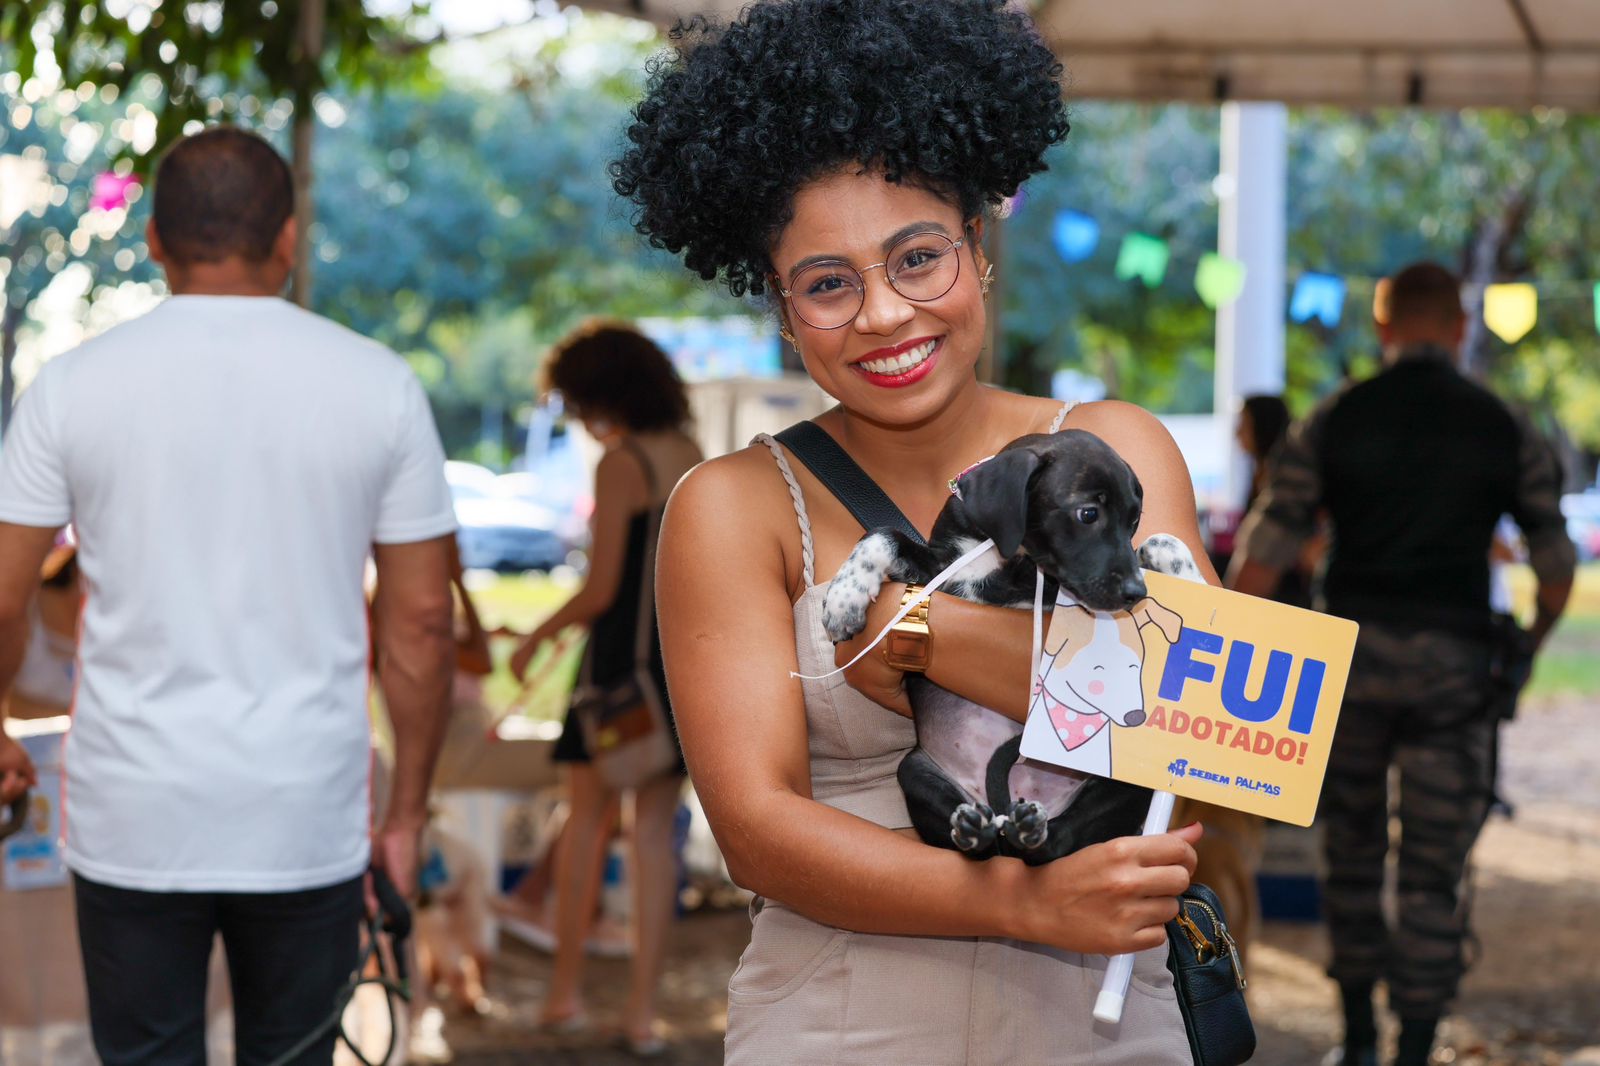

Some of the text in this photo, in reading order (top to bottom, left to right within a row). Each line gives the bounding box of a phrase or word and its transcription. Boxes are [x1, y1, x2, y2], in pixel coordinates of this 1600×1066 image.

[1158, 627, 1326, 735] FUI
[1145, 705, 1308, 765] ADOTADO!
[1188, 767, 1230, 785] SEBEM
[1235, 776, 1281, 796] PALMAS
